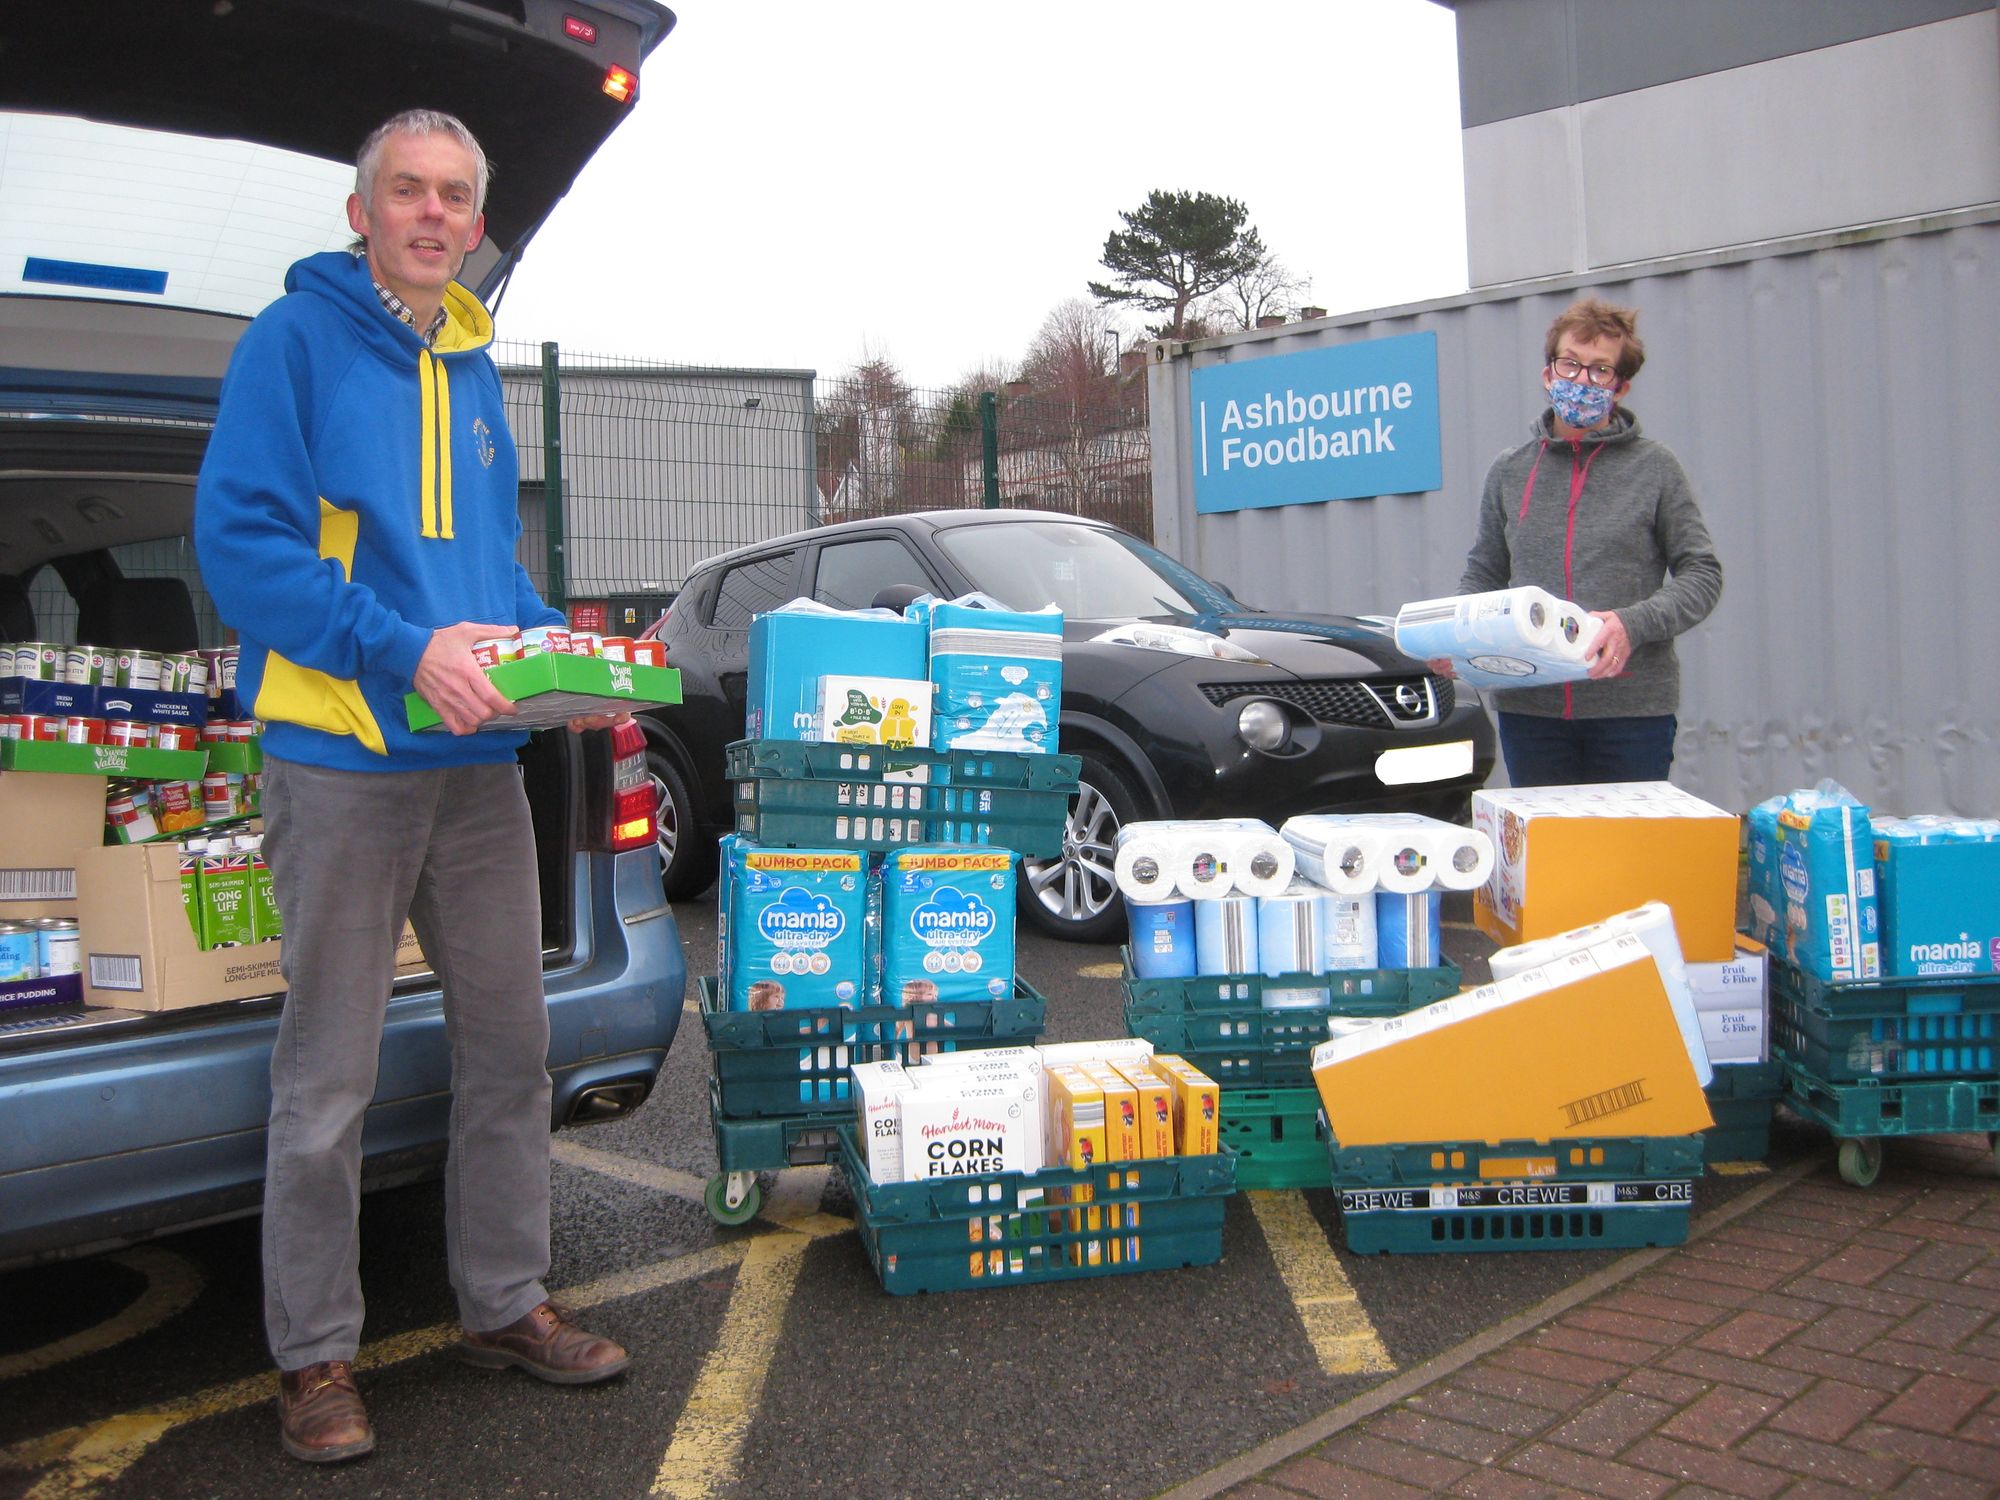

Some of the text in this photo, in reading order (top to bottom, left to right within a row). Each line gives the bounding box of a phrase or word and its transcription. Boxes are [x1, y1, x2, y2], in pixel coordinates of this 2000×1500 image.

[1221, 381, 1412, 433] Ashbourne
[1222, 418, 1396, 471] Foodbank
[615, 664, 633, 676] Sweet
[610, 674, 635, 694] Valley
[155, 703, 179, 711] CHICKEN
[104, 747, 128, 757] Sweet
[95, 755, 128, 770] Valley
[755, 857, 852, 868] JUMBO PACK
[910, 857, 1001, 868] JUMBO PACK
[754, 873, 762, 885] 5
[905, 873, 913, 885] 5
[213, 890, 242, 902] LONG
[217, 901, 239, 912] LIFE
[766, 902, 838, 928] mamia
[919, 901, 989, 928] mamia
[775, 929, 829, 941] ultra-dry
[927, 929, 980, 941] ultra-dry
[1910, 932, 1980, 961] mamia
[226, 959, 280, 975] SEMI-SKIMMED
[1722, 965, 1746, 975] Fruit
[1920, 961, 1972, 973] ultra-dry
[224, 966, 280, 983] LONG-LIFE MIL
[1722, 974, 1757, 984] & Fibre
[17, 988, 57, 1000] PUDDING
[1722, 1014, 1746, 1023] Fruit
[1722, 1024, 1757, 1033] & Fibre
[921, 1116, 1007, 1139] Harvest Morn
[927, 1137, 1003, 1160] CORN
[929, 1157, 1004, 1176] FLAKES
[1342, 1191, 1413, 1210] CREWE
[1459, 1190, 1481, 1200] M&S
[1497, 1187, 1570, 1205] CREWE
[1617, 1186, 1639, 1196] M&S
[1655, 1184, 1692, 1200] CRE
